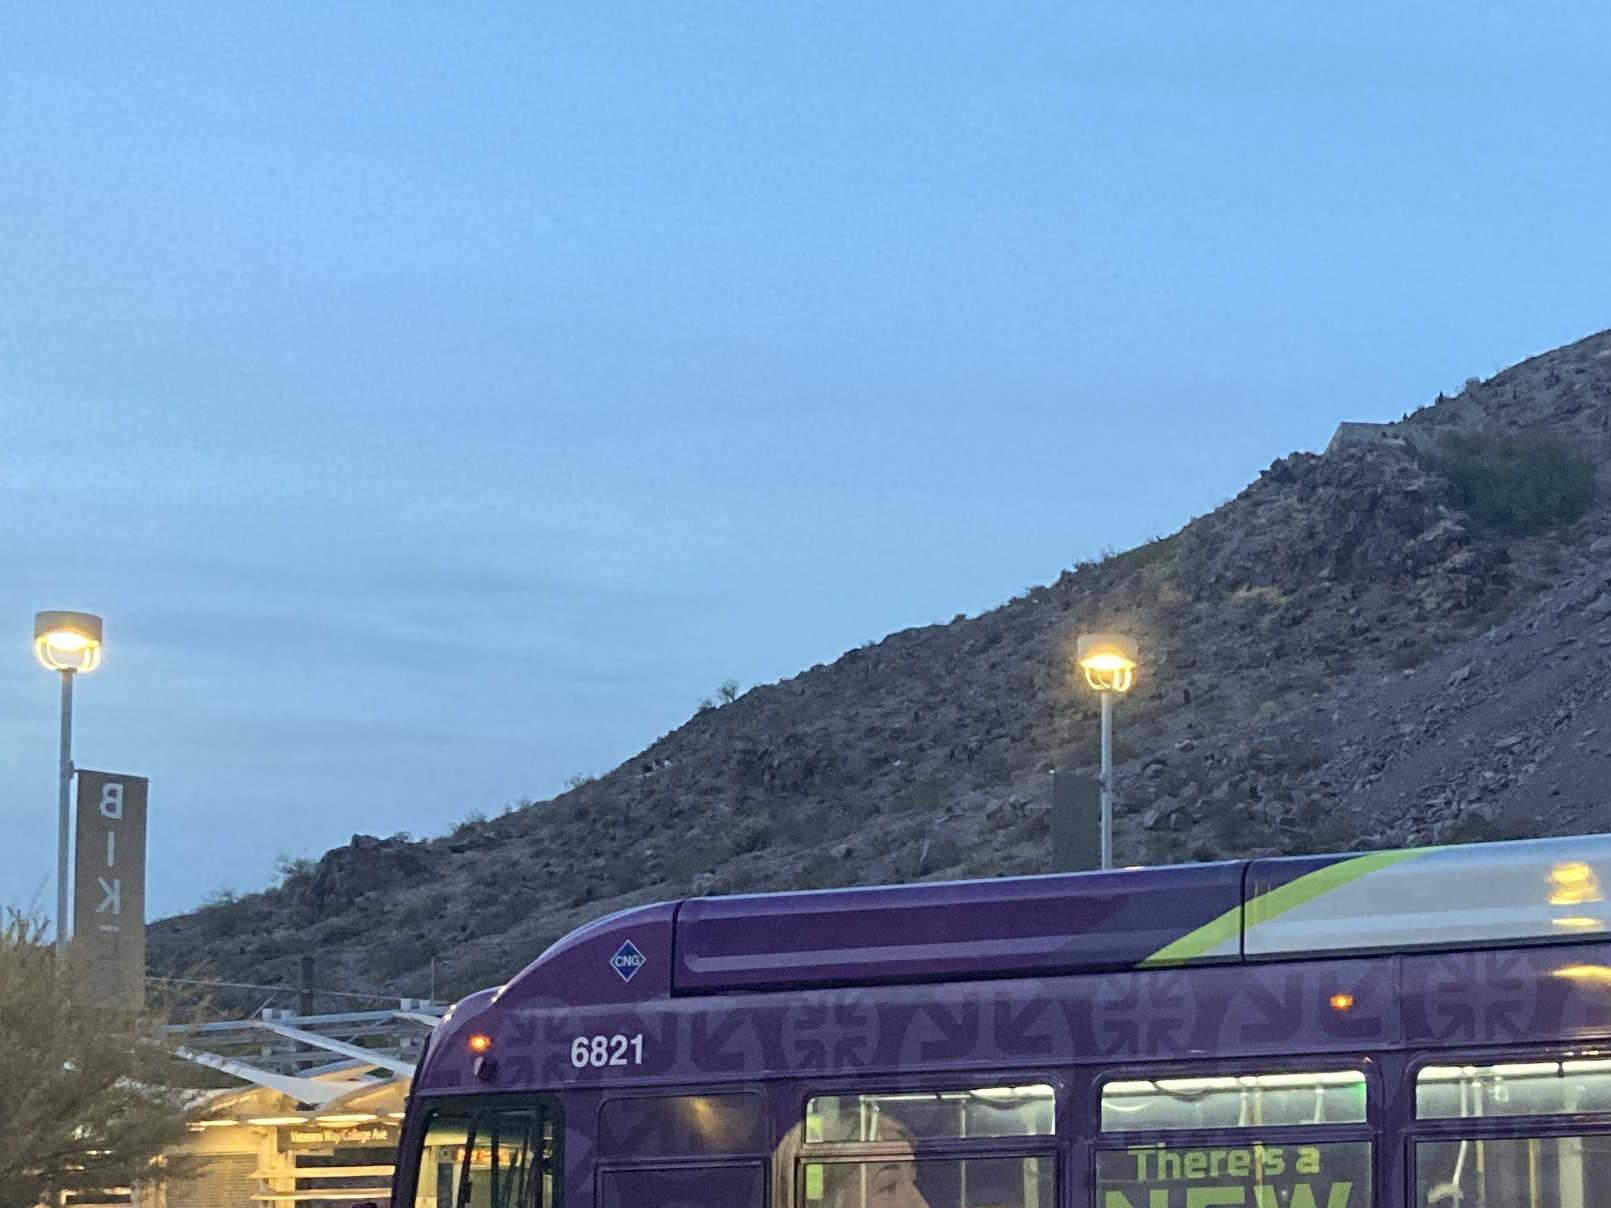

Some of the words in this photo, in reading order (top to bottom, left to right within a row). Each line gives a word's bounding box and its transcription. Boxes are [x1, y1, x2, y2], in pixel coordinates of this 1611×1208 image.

[615, 955, 640, 967] CNG
[571, 1033, 643, 1068] 6821
[1296, 1146, 1320, 1174] a
